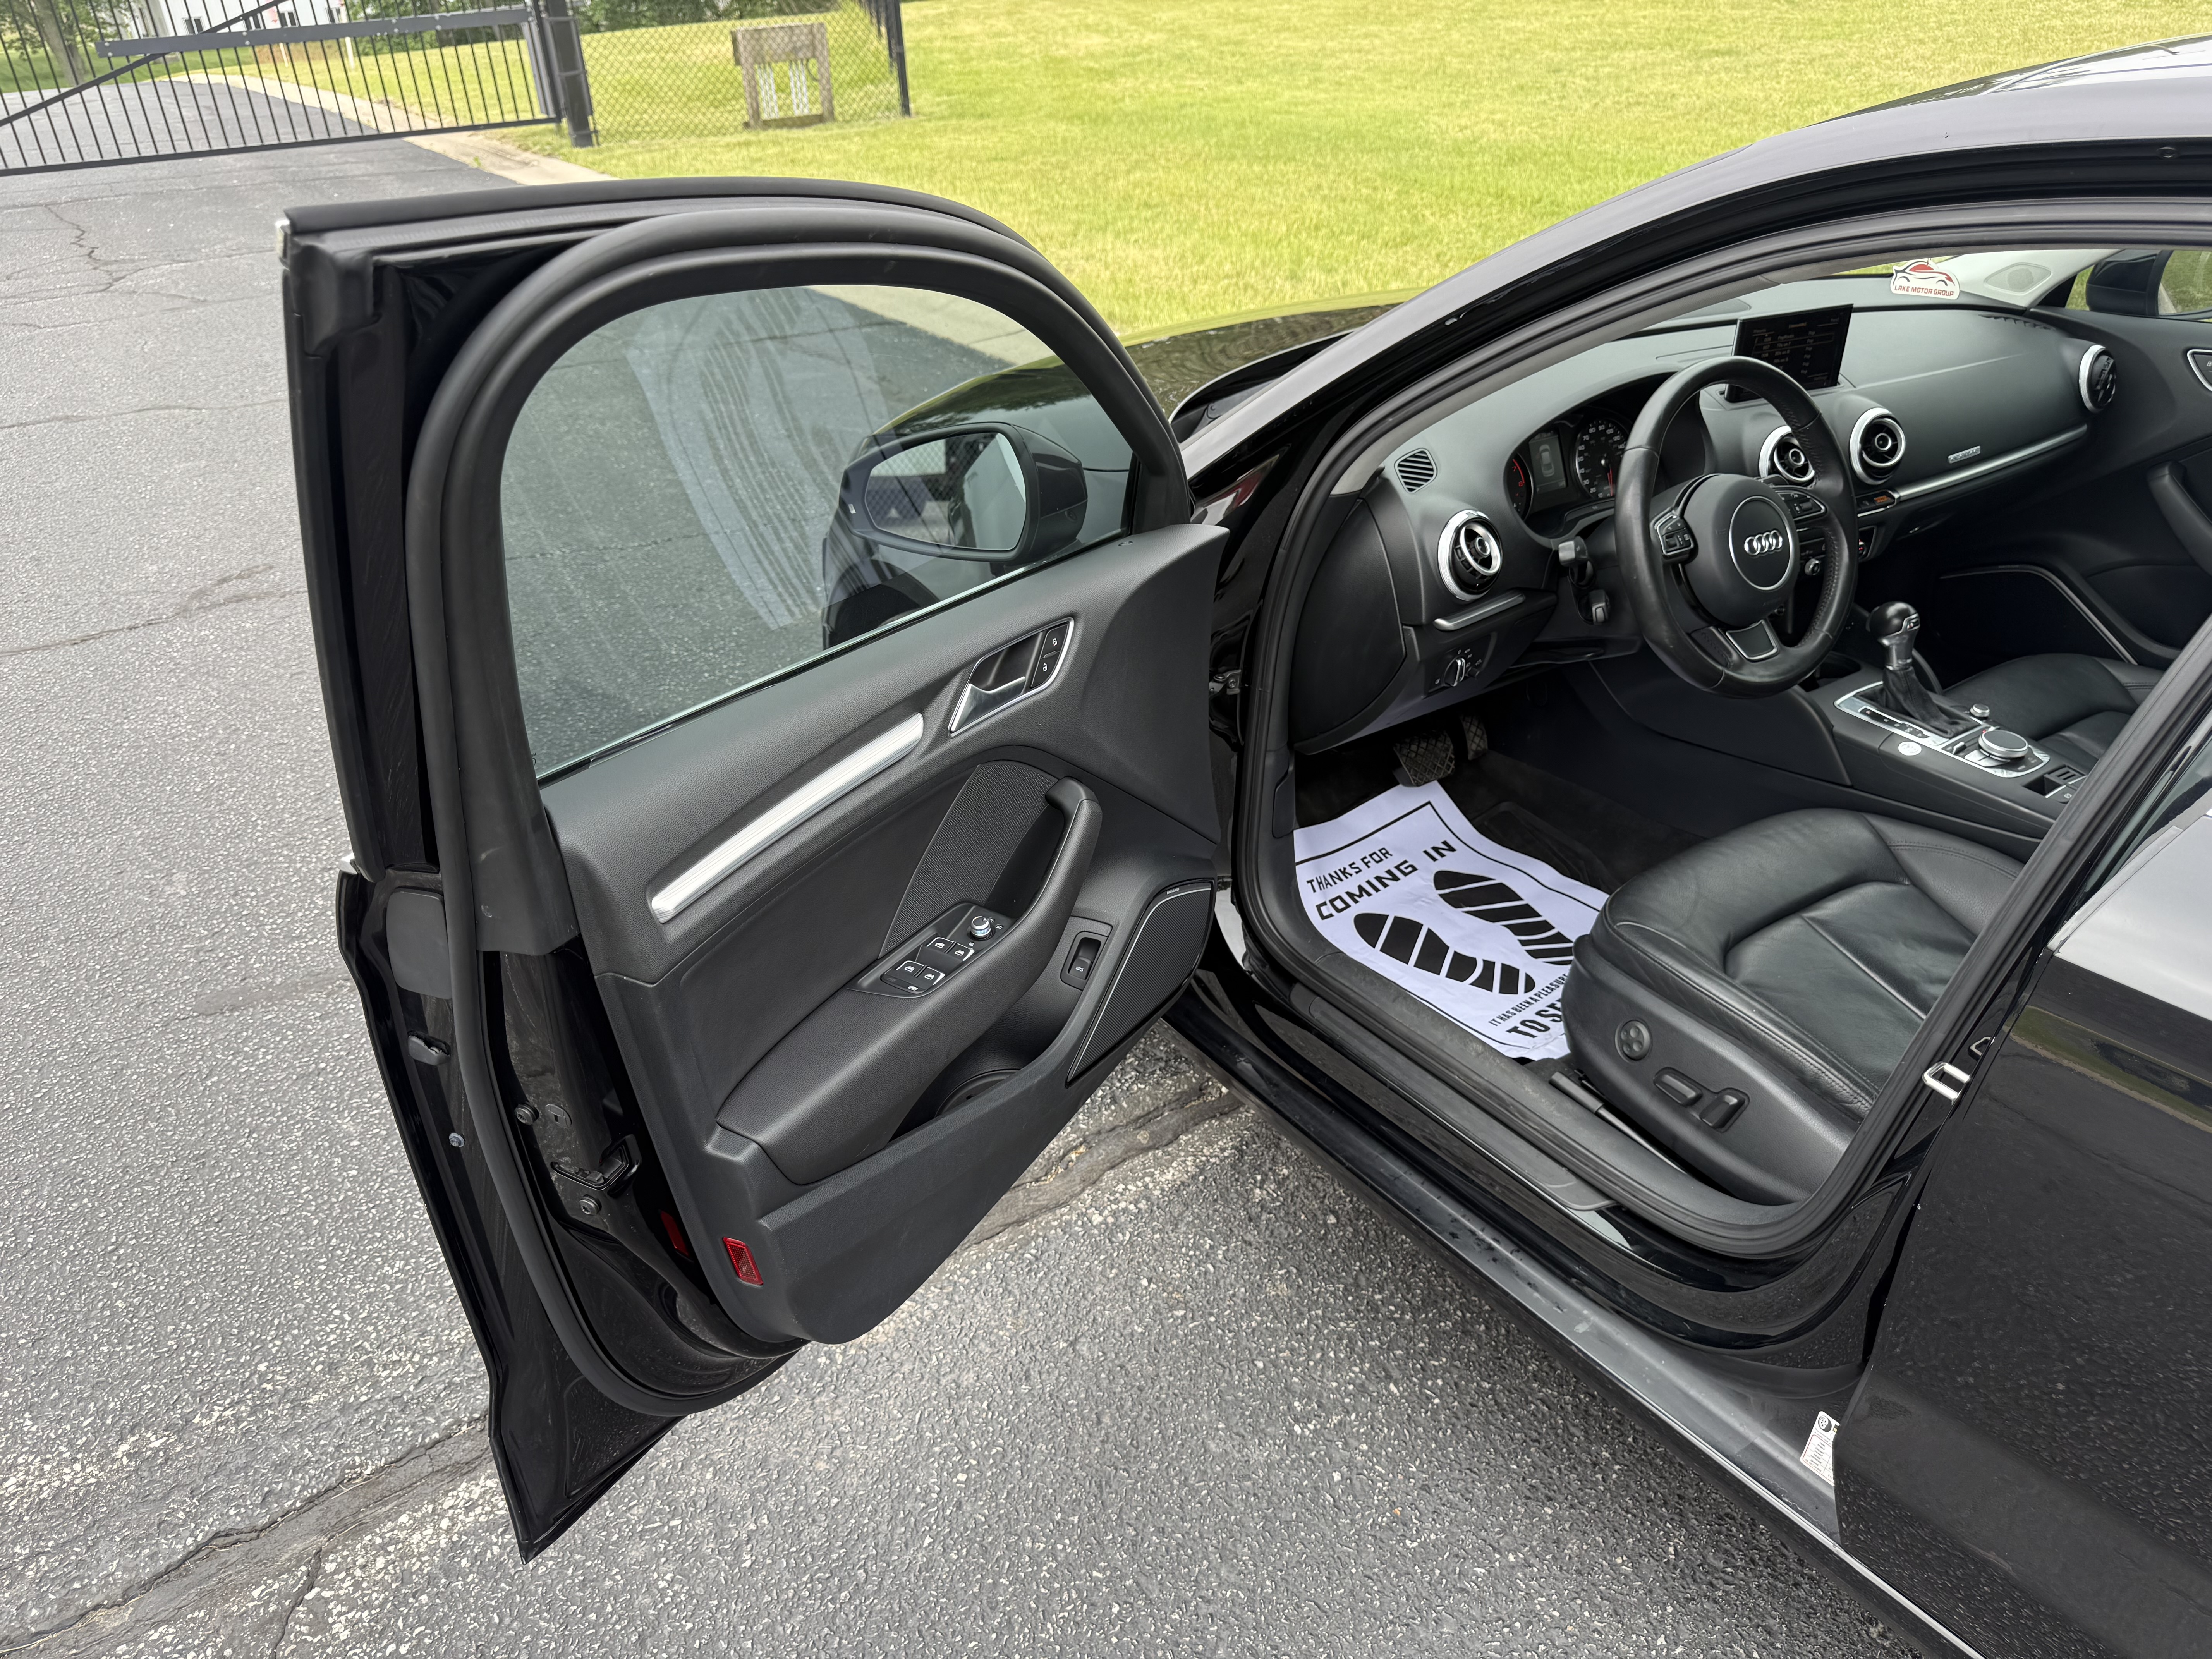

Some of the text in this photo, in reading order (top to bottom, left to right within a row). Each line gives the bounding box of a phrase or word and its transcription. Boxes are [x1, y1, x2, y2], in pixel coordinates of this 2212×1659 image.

[1307, 847, 1393, 893] THANKS FOR
[1316, 840, 1457, 920] COMING IN
[1496, 1010, 1516, 1022] HAS
[1511, 1000, 1534, 1013] BEEN
[1506, 1020, 1550, 1038] TO
